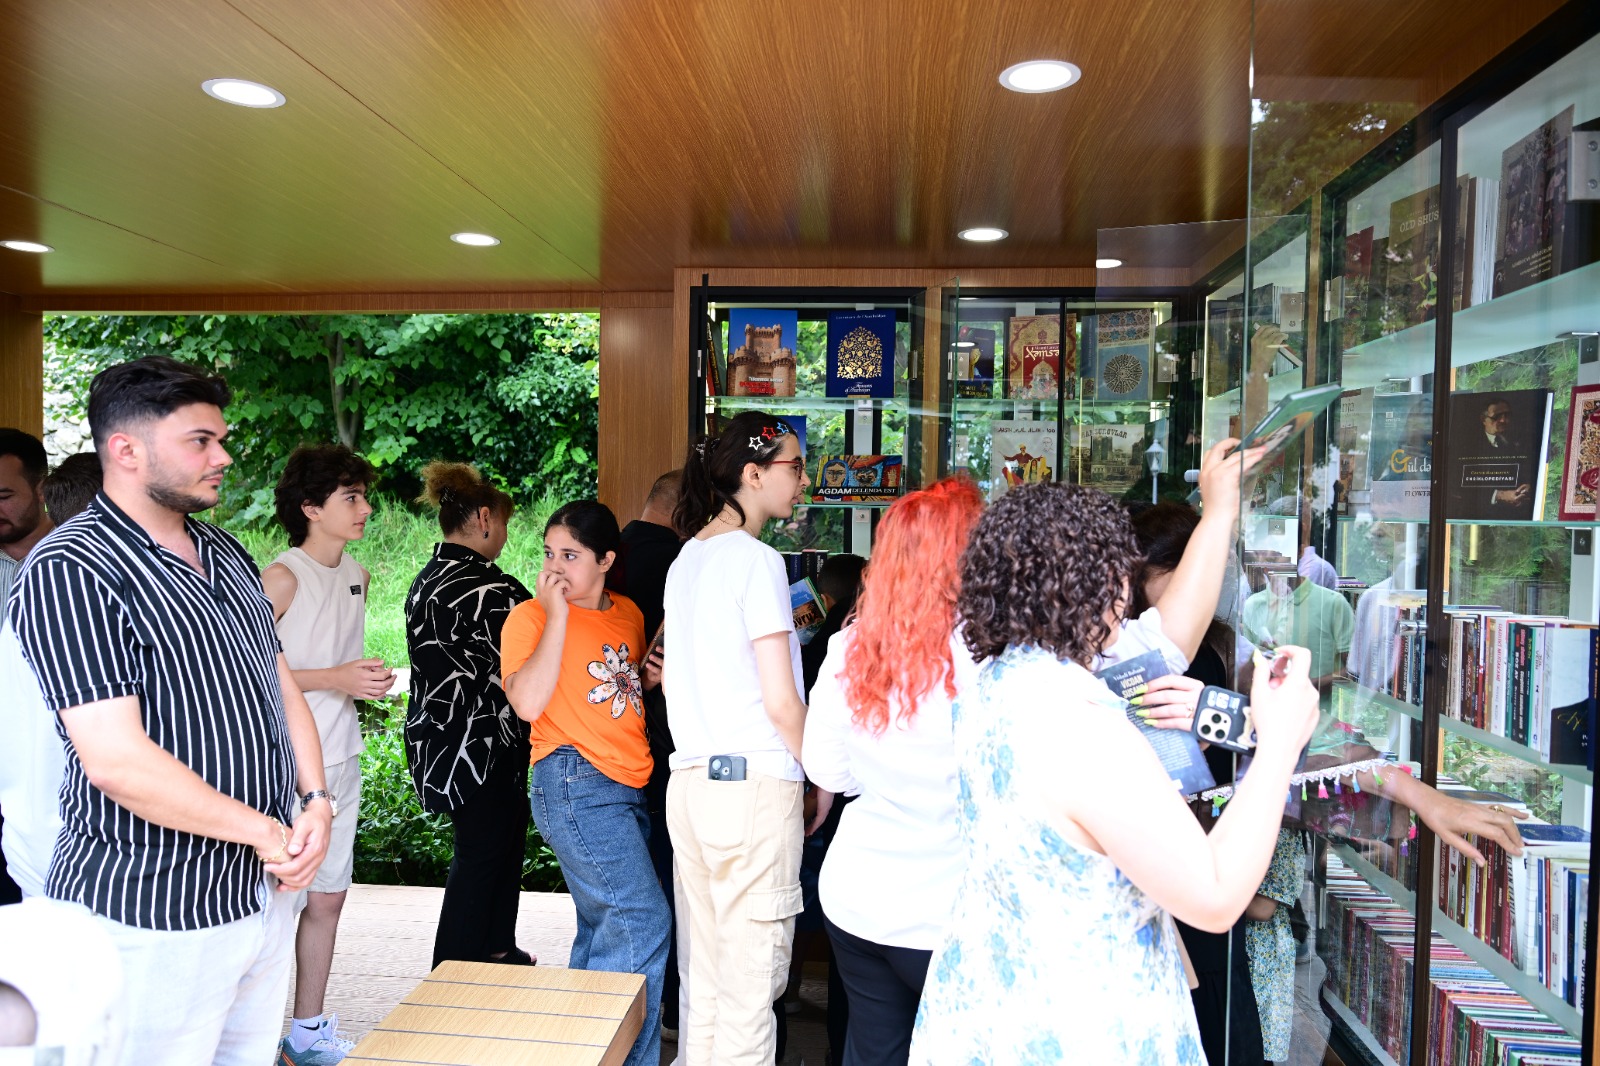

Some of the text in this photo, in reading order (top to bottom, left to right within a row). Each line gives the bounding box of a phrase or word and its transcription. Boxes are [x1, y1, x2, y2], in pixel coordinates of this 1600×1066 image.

[1400, 219, 1416, 233] OLD
[1390, 448, 1418, 474] Gül
[817, 487, 852, 495] AGDAM
